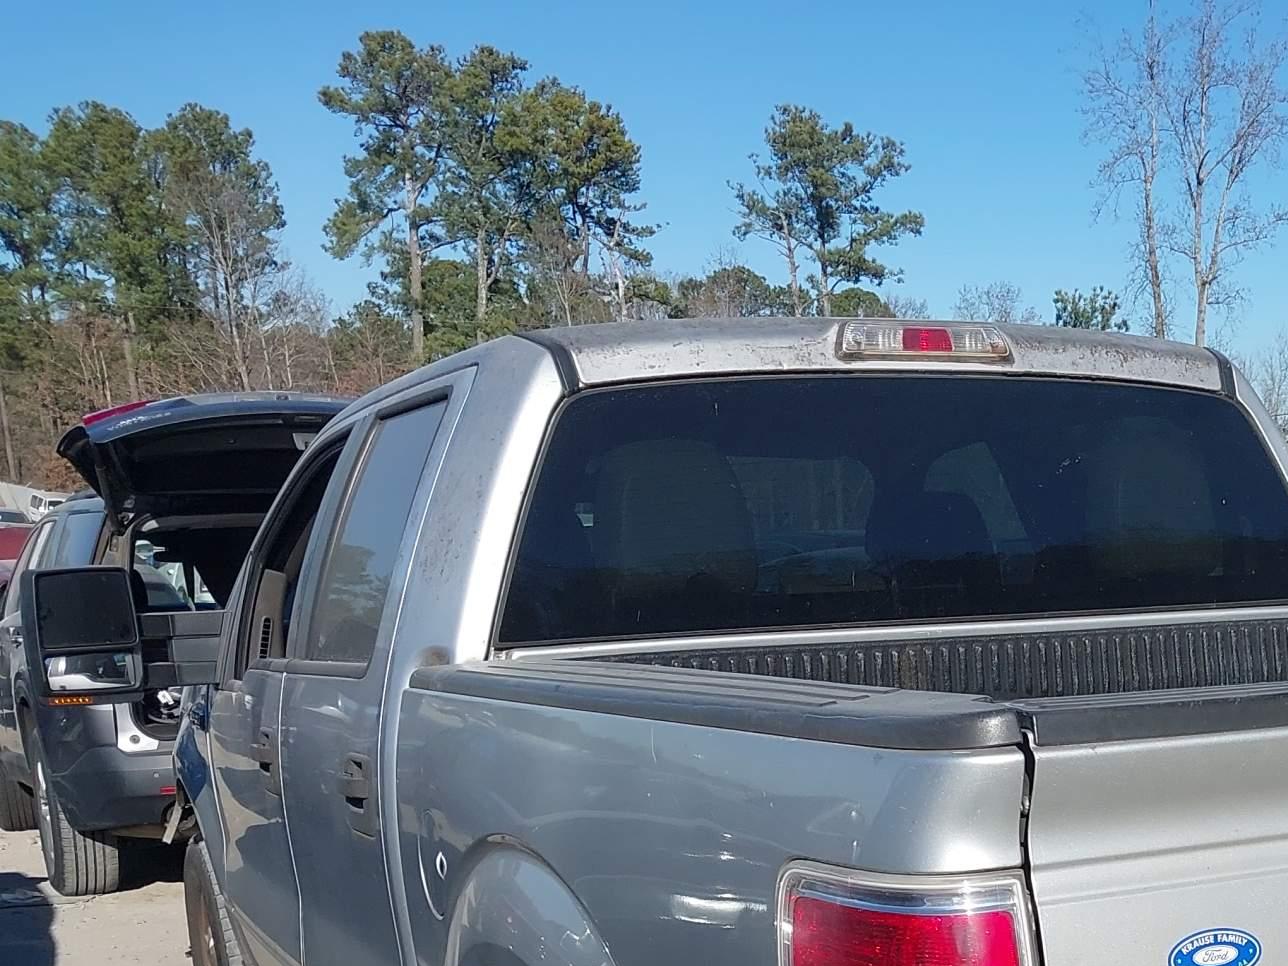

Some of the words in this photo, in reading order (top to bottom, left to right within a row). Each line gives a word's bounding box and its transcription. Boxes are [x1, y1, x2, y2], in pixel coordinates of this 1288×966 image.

[1181, 935, 1215, 956] KRAUSE
[1217, 933, 1248, 947] FAMILY
[1203, 949, 1229, 963] Ford
